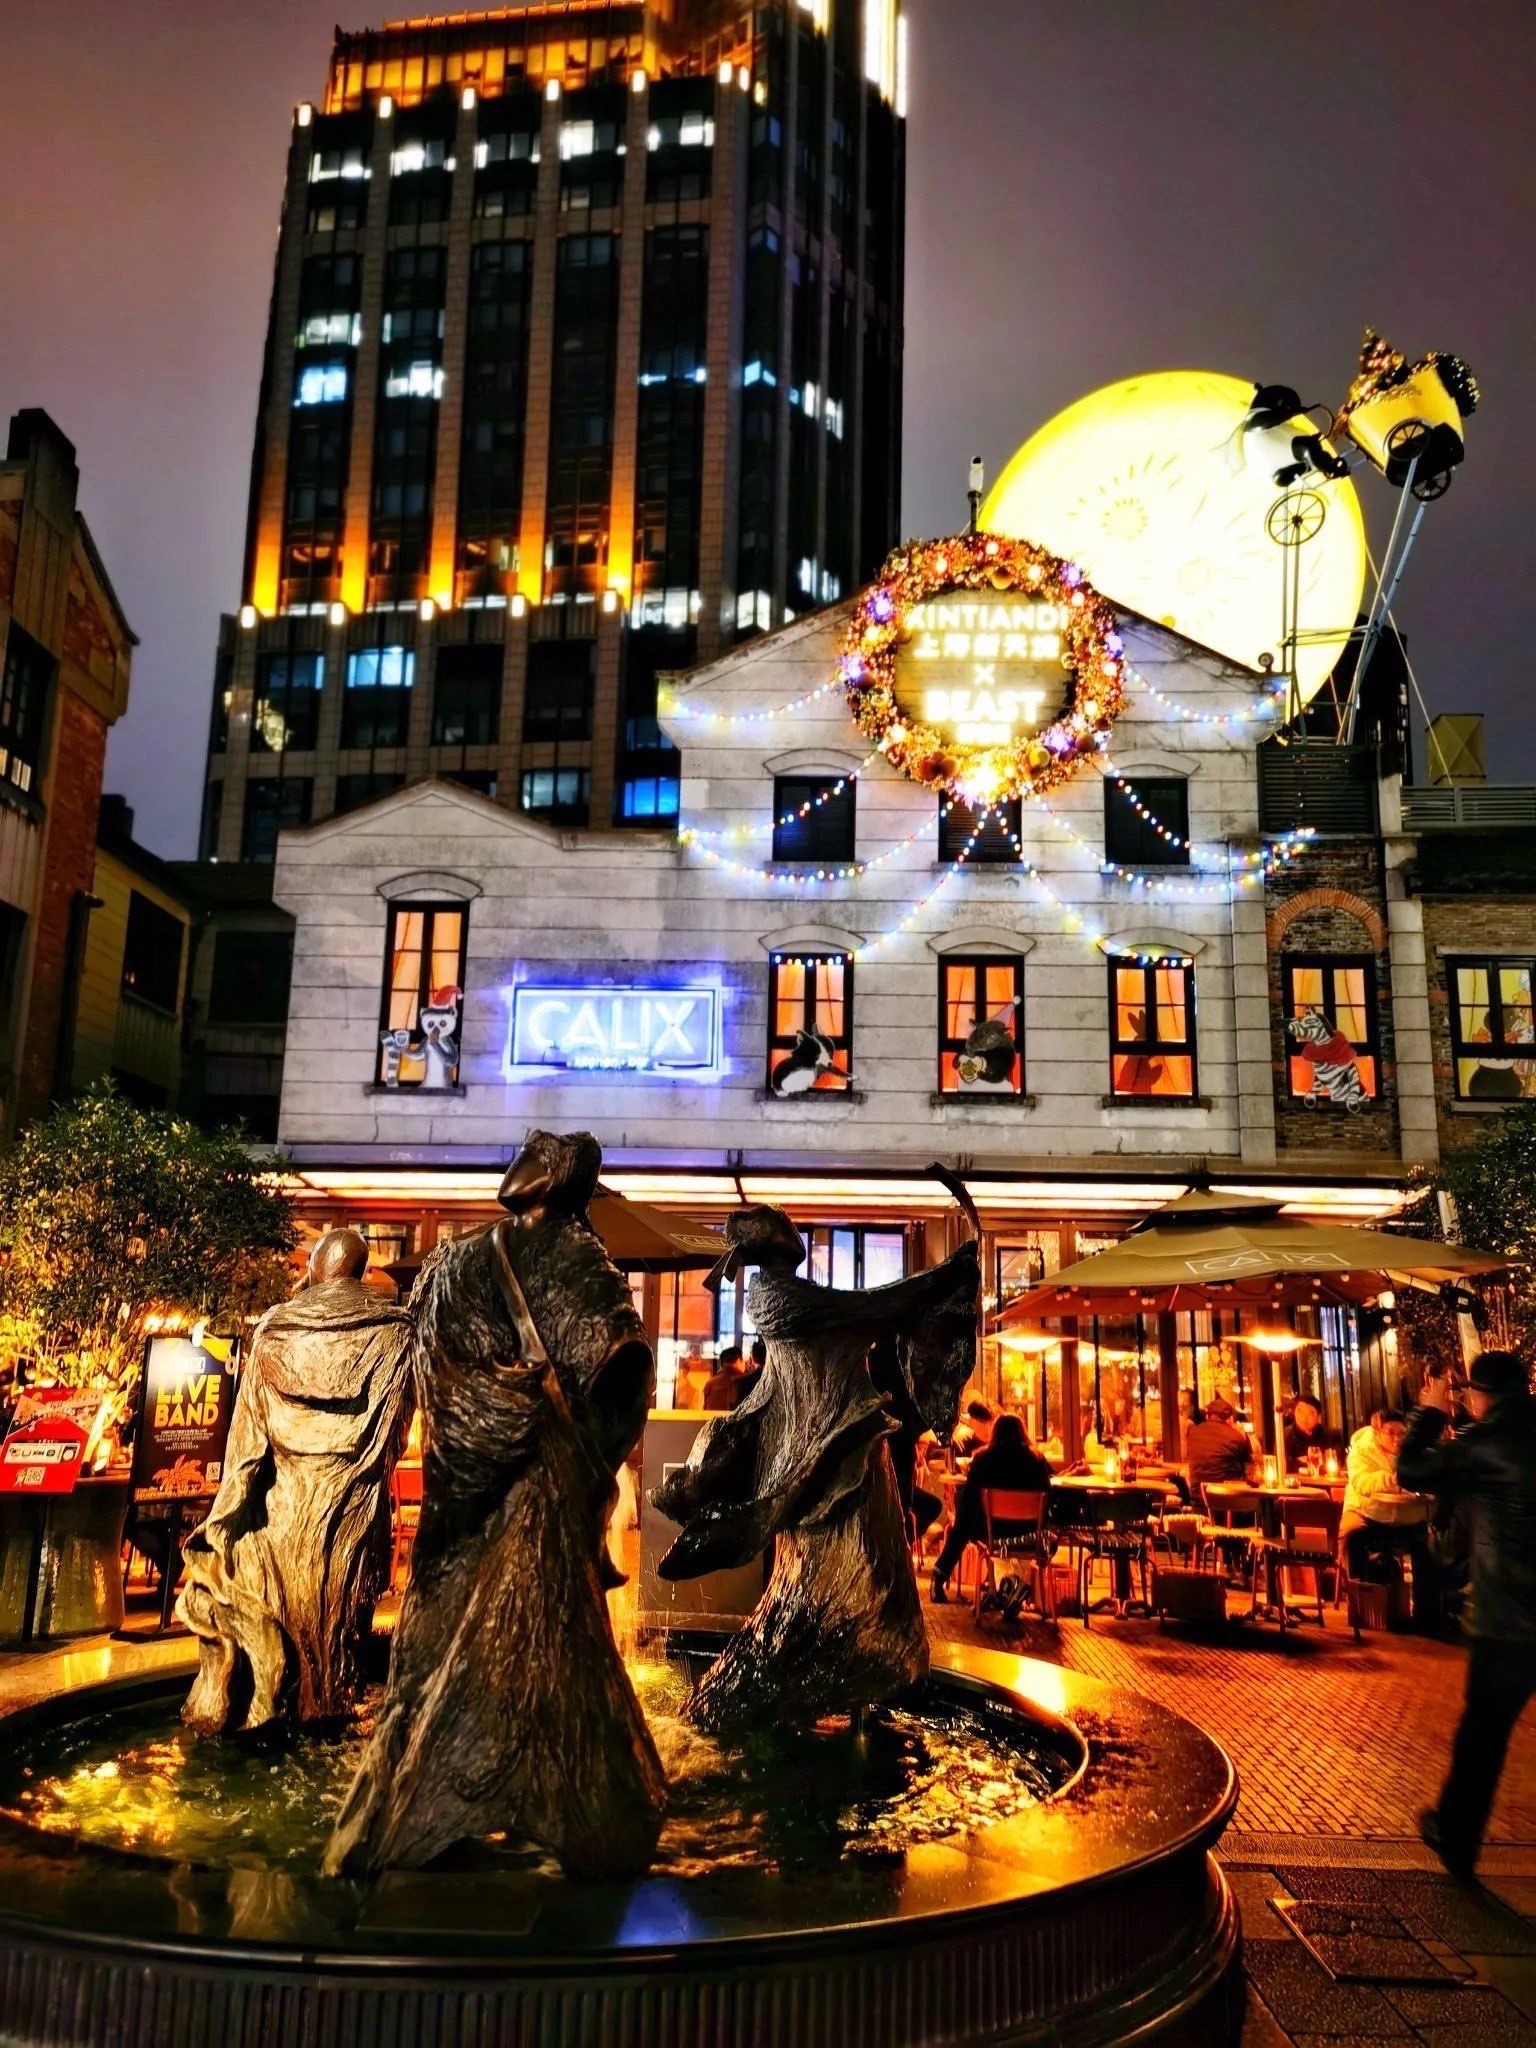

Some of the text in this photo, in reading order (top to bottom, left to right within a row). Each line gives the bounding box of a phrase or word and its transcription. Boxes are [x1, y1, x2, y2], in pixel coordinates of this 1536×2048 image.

[906, 604, 1069, 630] XINTIANDI
[926, 691, 1045, 723] BEAST
[527, 1000, 695, 1054] CALIX
[156, 1375, 221, 1404] LIVE
[154, 1402, 219, 1427] BAND
